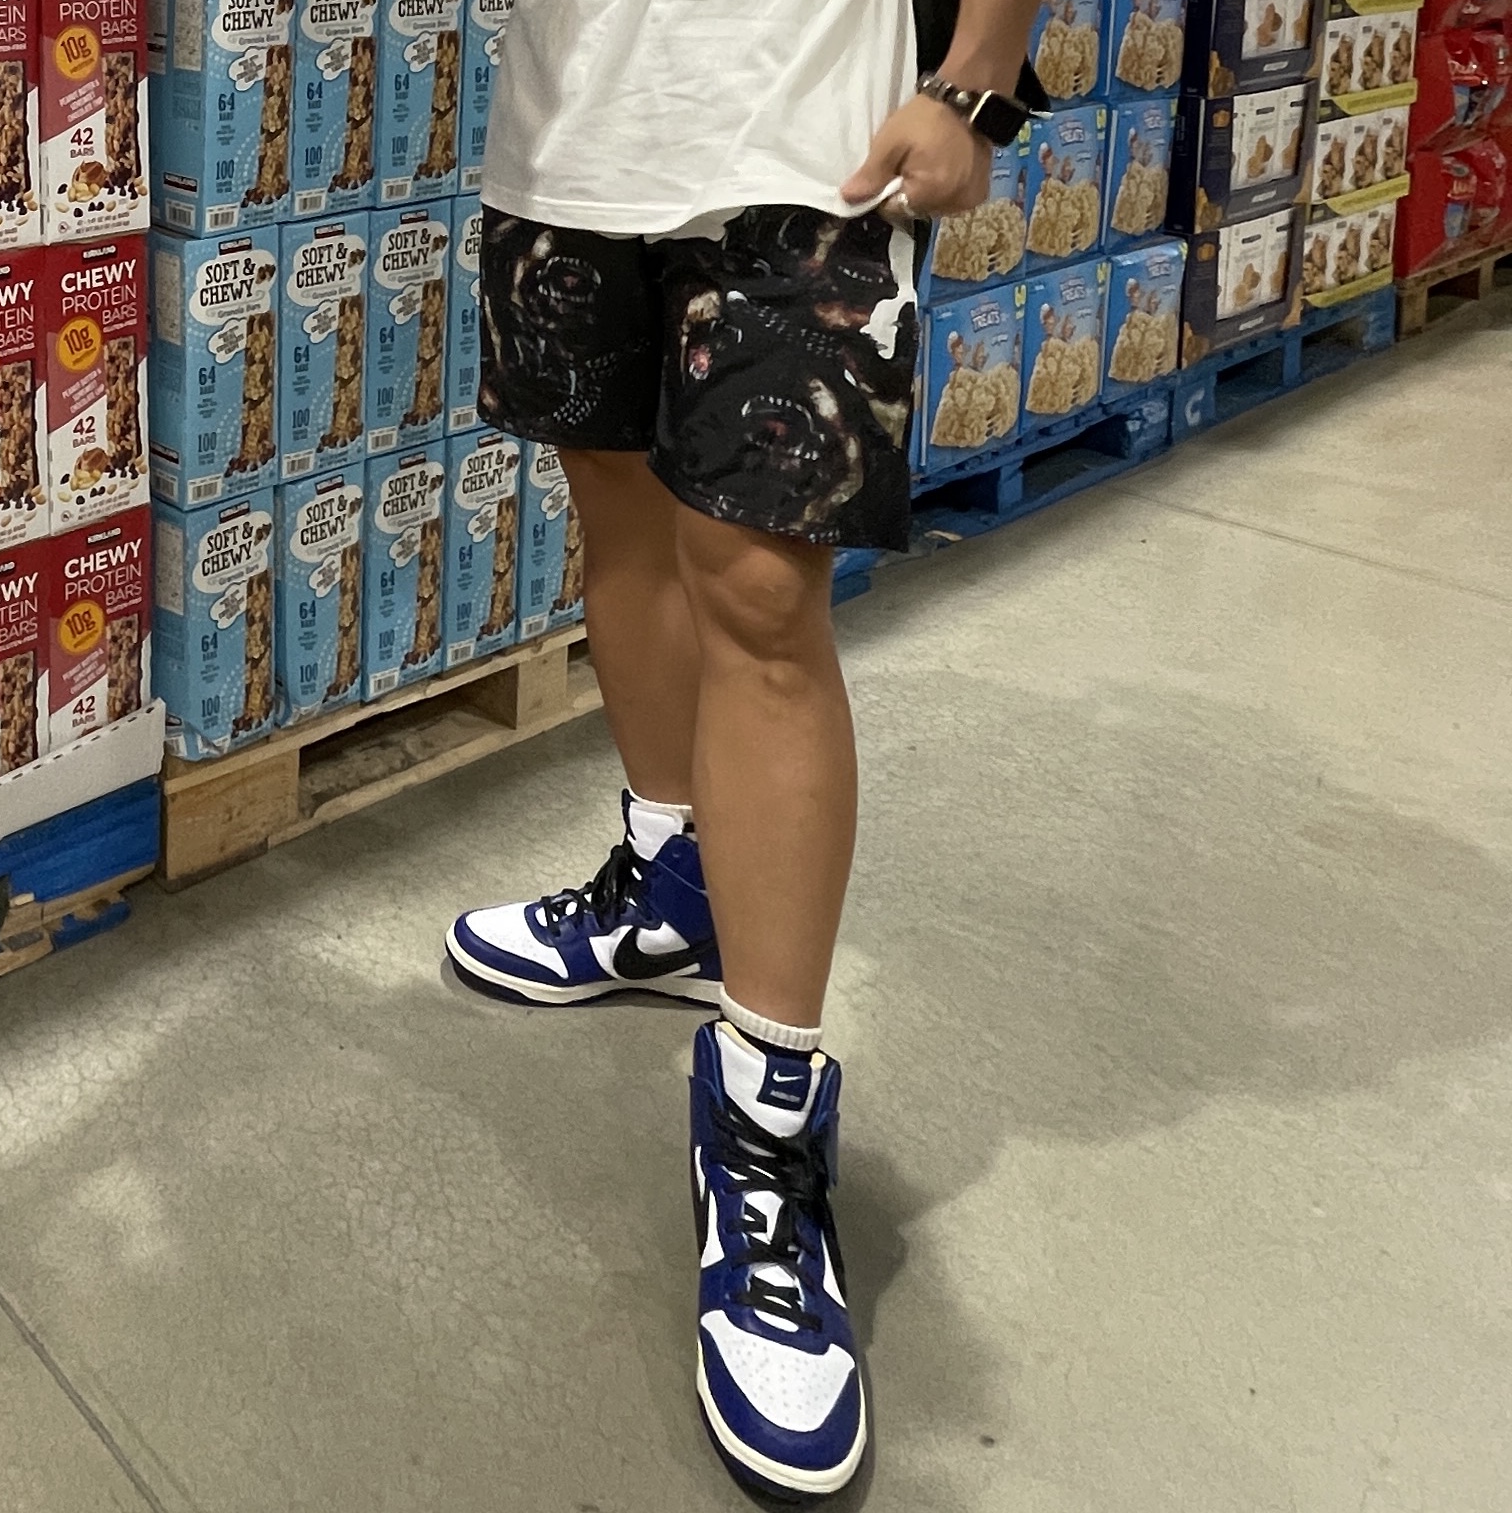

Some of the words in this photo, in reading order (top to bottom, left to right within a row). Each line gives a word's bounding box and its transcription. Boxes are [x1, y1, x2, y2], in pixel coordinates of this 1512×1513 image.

[223, 8, 274, 31] CHEWY
[394, 73, 408, 91] 64
[219, 92, 234, 111] 64
[391, 136, 408, 154] 100
[216, 159, 234, 180] 100
[302, 244, 333, 268] SOFT
[337, 243, 347, 259] &
[297, 262, 346, 288] CHEWY
[294, 345, 309, 364] 64
[292, 408, 309, 428] 100
[467, 452, 493, 475] SOFT
[496, 450, 505, 465] &
[463, 467, 504, 494] CHEWY
[207, 526, 238, 555] SOFT
[242, 522, 253, 539] &
[67, 538, 143, 579] CHEWY
[202, 540, 252, 577] CHEWY
[459, 544, 472, 562] 64
[67, 561, 142, 601] PROTEIN
[106, 582, 142, 605] BARS
[67, 608, 95, 638] 10g
[202, 632, 218, 653] 64
[74, 696, 95, 715] 42
[203, 695, 221, 719] 100
